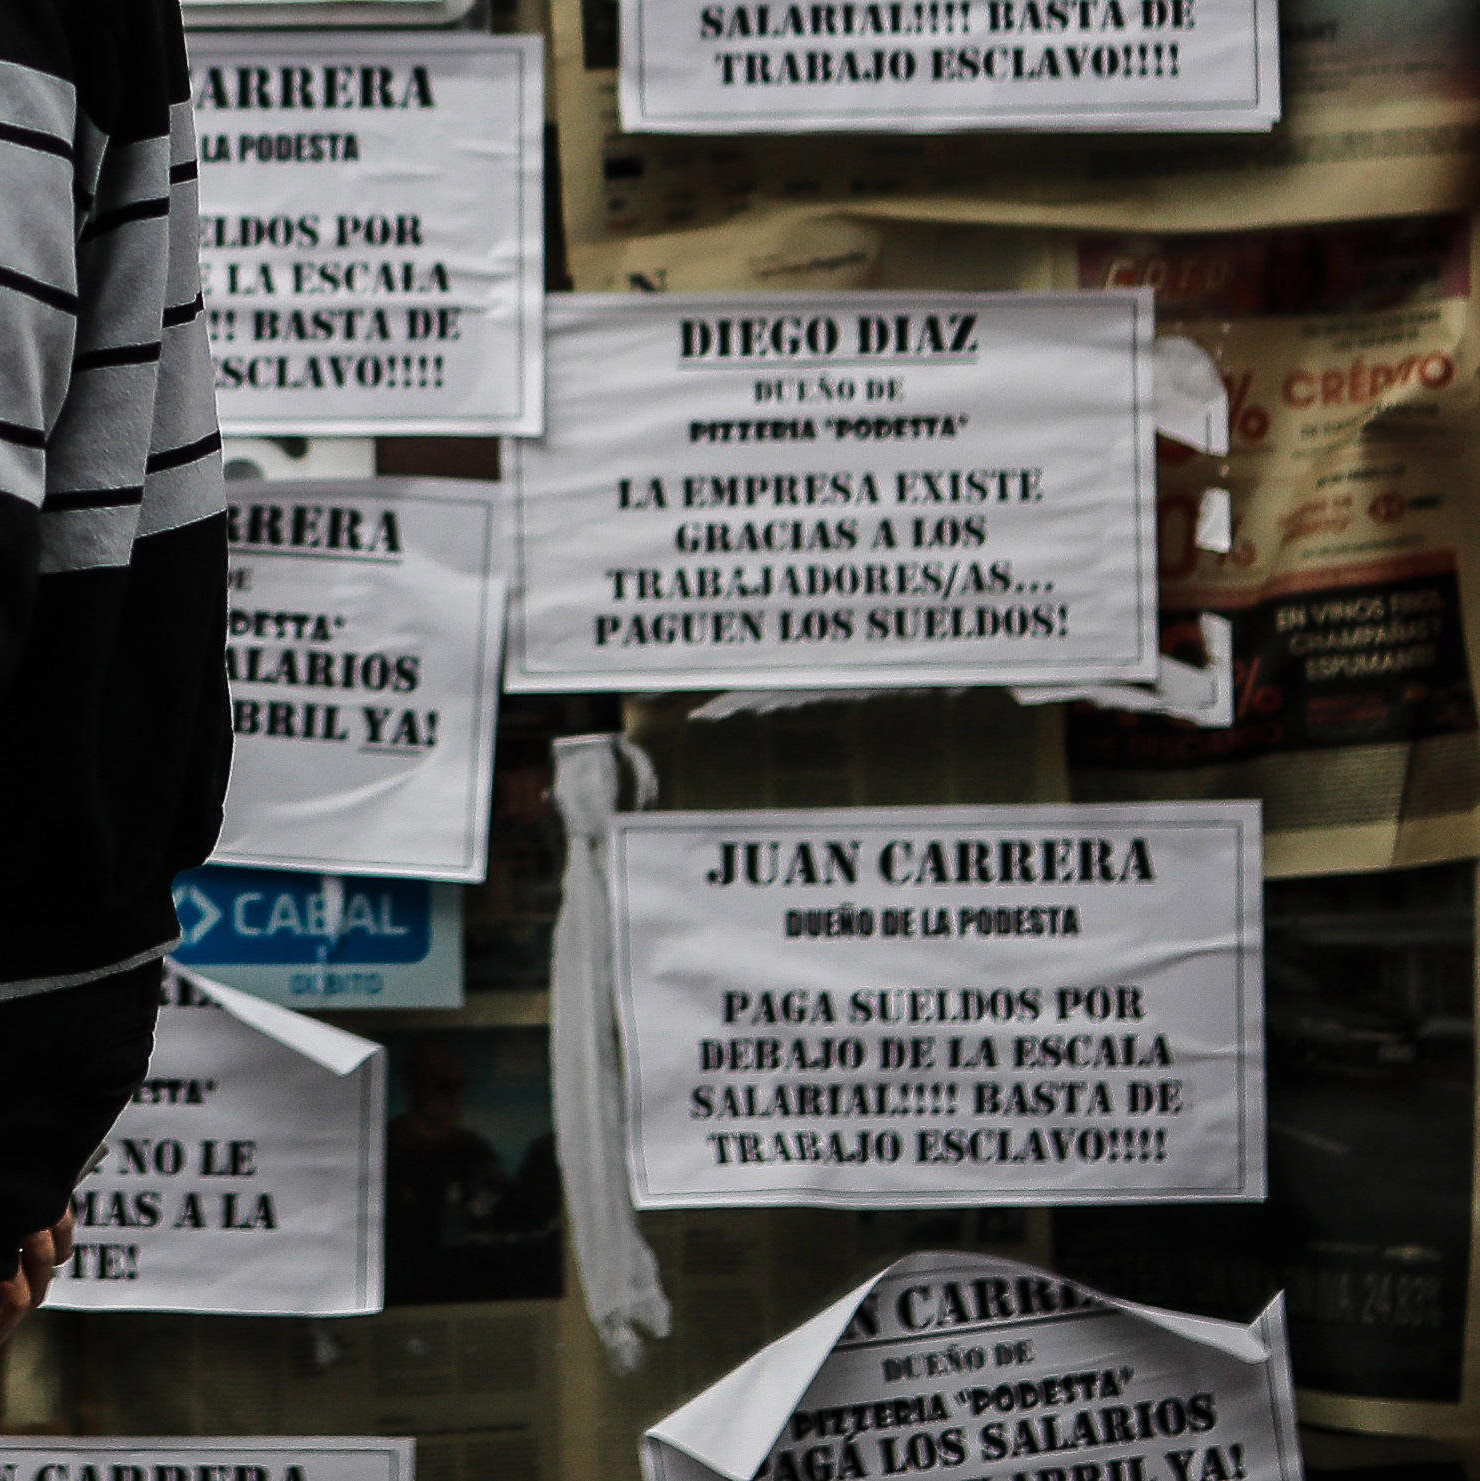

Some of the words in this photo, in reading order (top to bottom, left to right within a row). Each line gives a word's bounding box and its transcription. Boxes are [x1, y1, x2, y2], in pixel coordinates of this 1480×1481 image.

[698, 0, 973, 40] SALARIAL!!!!
[250, 307, 392, 342] BASTA
[404, 307, 463, 341] DE
[593, 610, 765, 647] PAGUEN
[777, 608, 855, 642] LOS
[865, 604, 1069, 640] SUELDOS!
[361, 706, 439, 748] YA!
[705, 840, 861, 887] JUAN
[876, 836, 1156, 884] CARRERA
[699, 1037, 867, 1072] DEBAJO
[877, 1036, 936, 1071] DE
[945, 1036, 1000, 1070] LA
[1011, 1034, 1177, 1069] ESCALA
